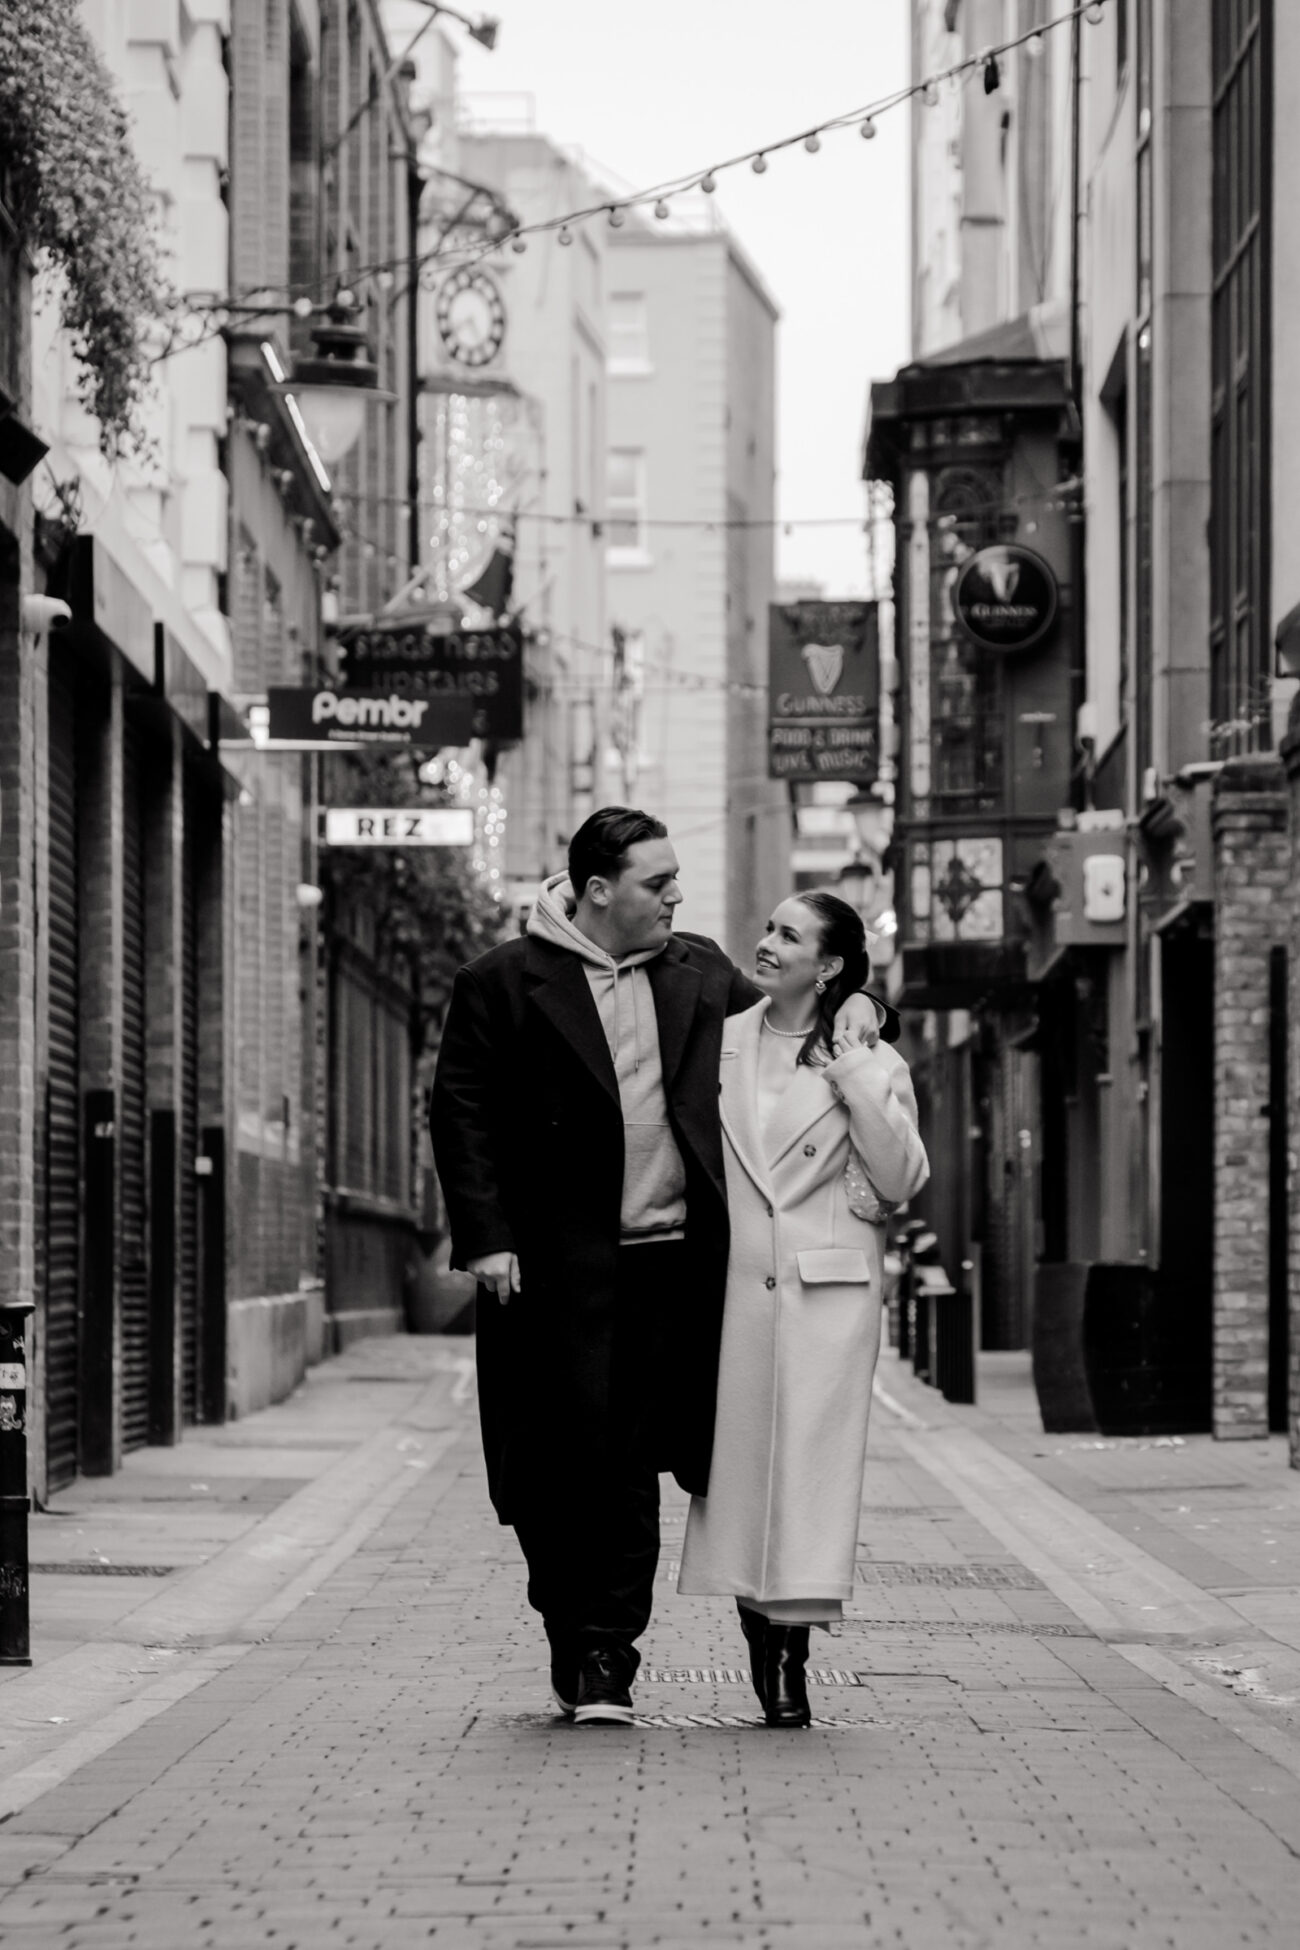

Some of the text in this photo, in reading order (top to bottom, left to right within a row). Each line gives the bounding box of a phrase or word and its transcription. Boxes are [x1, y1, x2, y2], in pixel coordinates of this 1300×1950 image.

[971, 604, 1038, 618] GUINNESS
[312, 691, 429, 728] Pembr
[776, 693, 867, 716] GUINNESS
[357, 817, 422, 837] REZ
